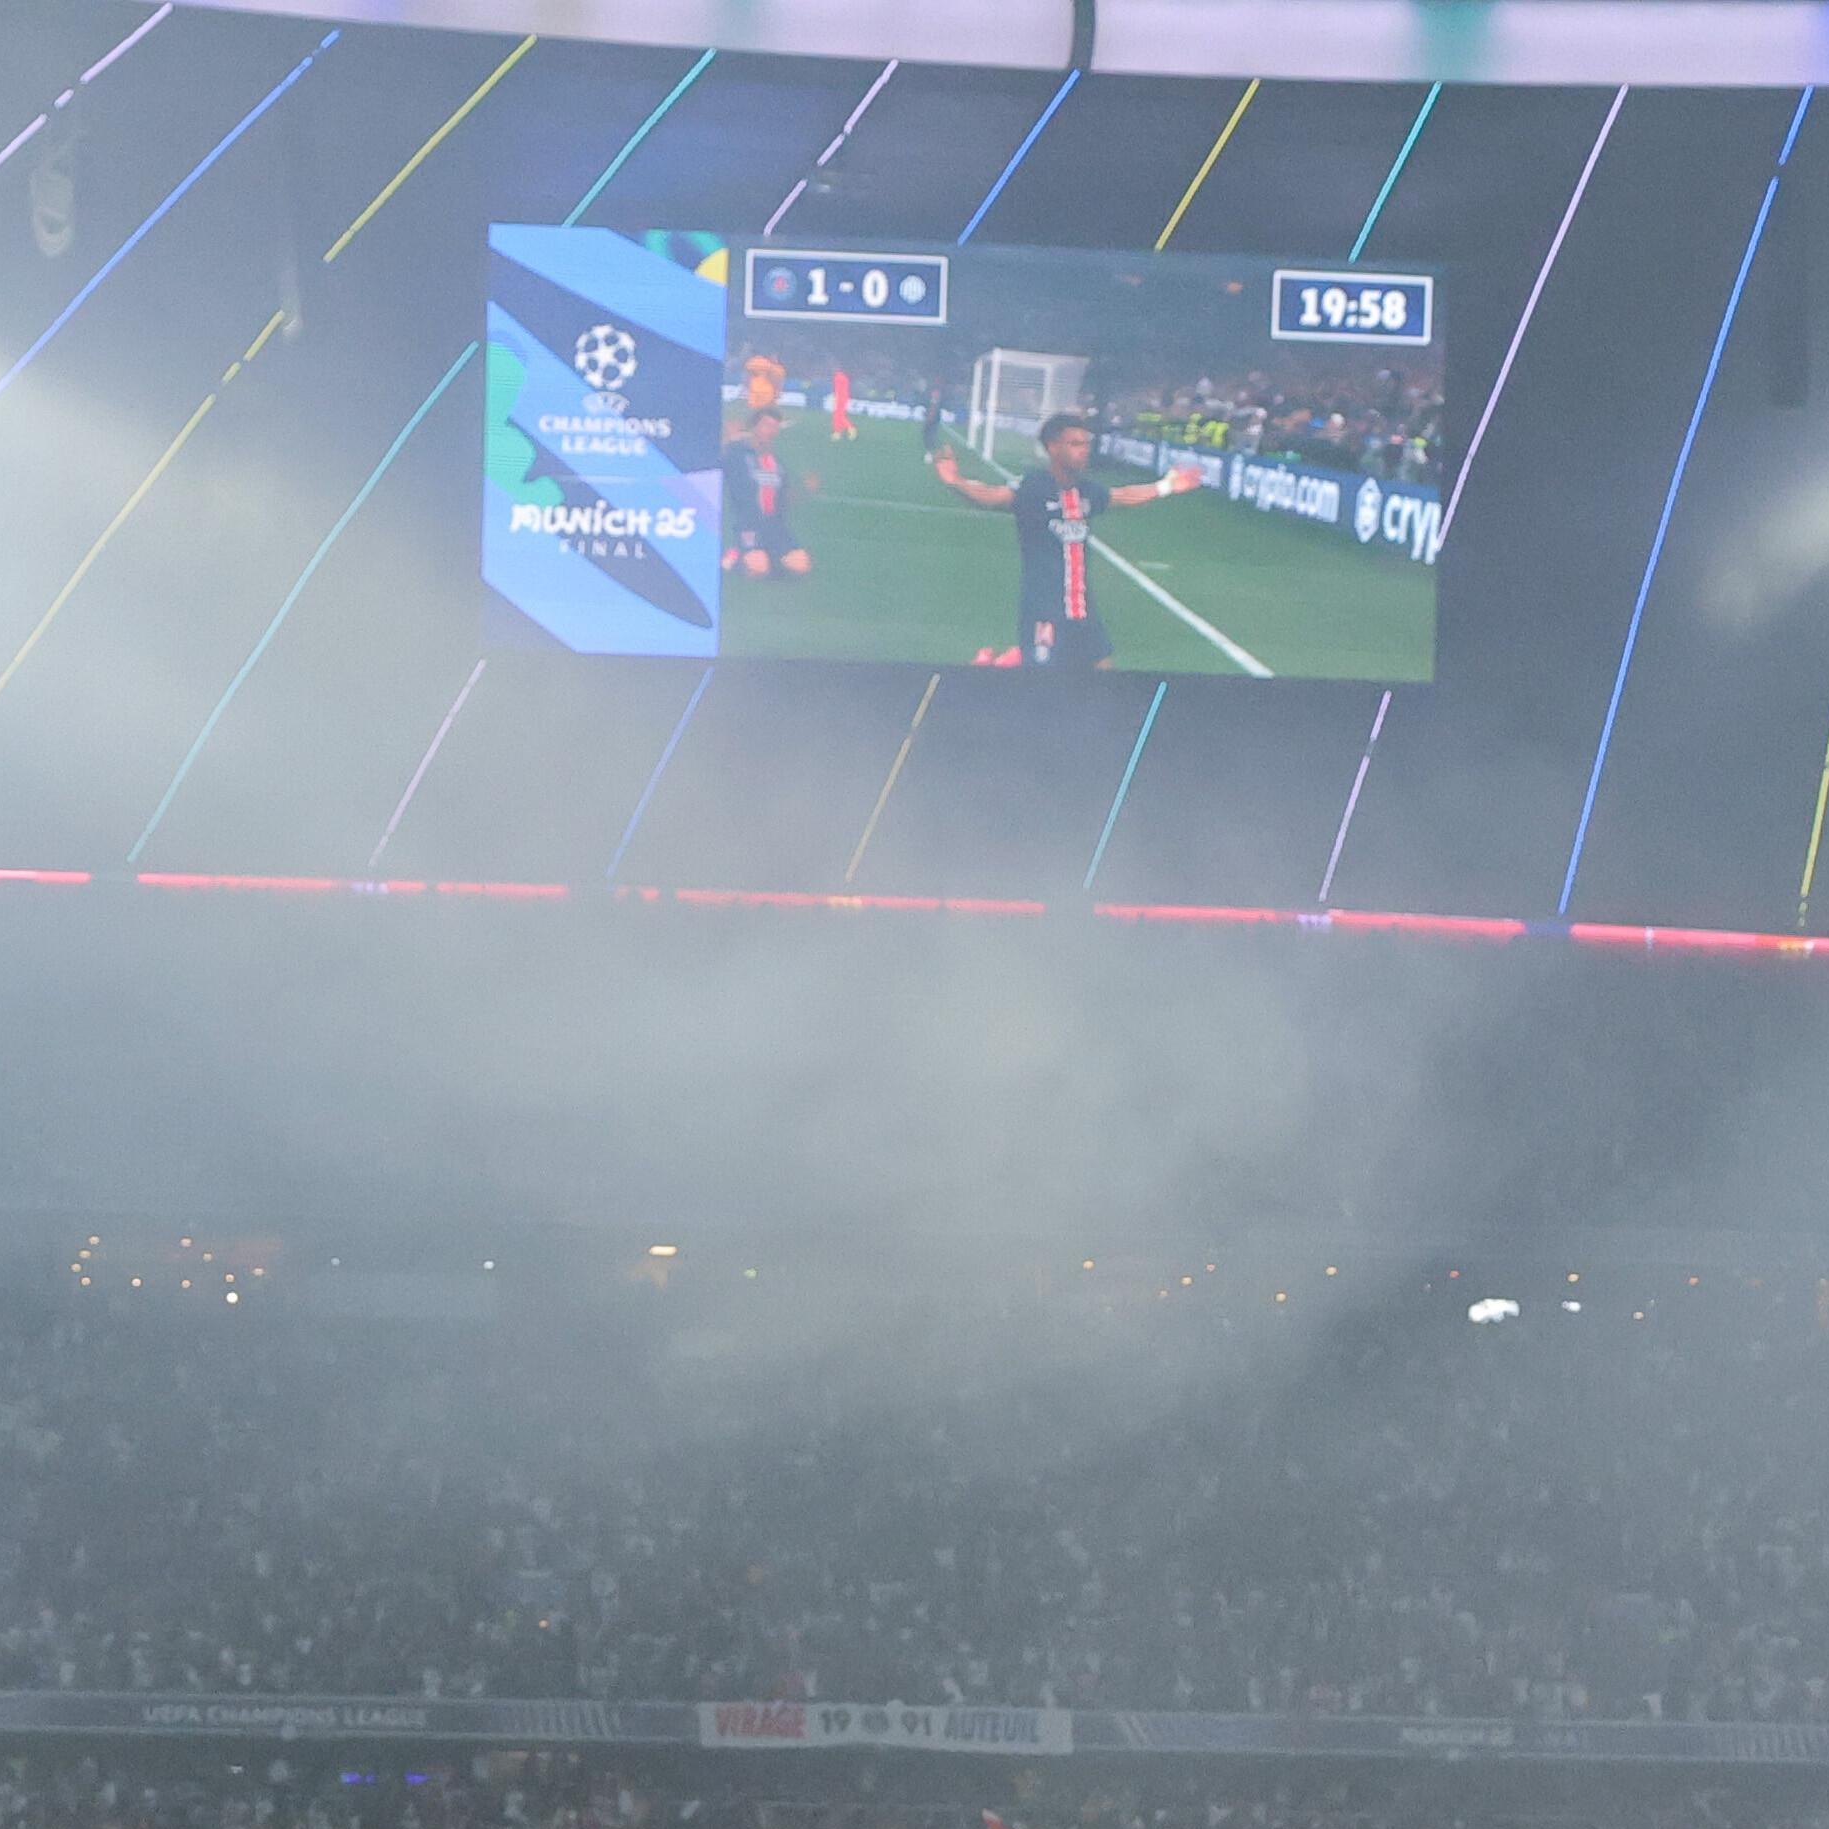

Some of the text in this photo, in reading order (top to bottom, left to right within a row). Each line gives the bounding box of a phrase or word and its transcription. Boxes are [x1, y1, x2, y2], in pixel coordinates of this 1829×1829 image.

[807, 268, 830, 306] 1
[862, 269, 889, 308] 0
[1299, 288, 1407, 330] 19:58
[538, 414, 671, 438] CHAMPIONS
[560, 436, 648, 455] LEAGUE
[655, 507, 697, 538] 25
[559, 538, 646, 560] FINAL
[207, 1705, 337, 1726] CHAMPIONS
[343, 1707, 427, 1728] LEAGUE
